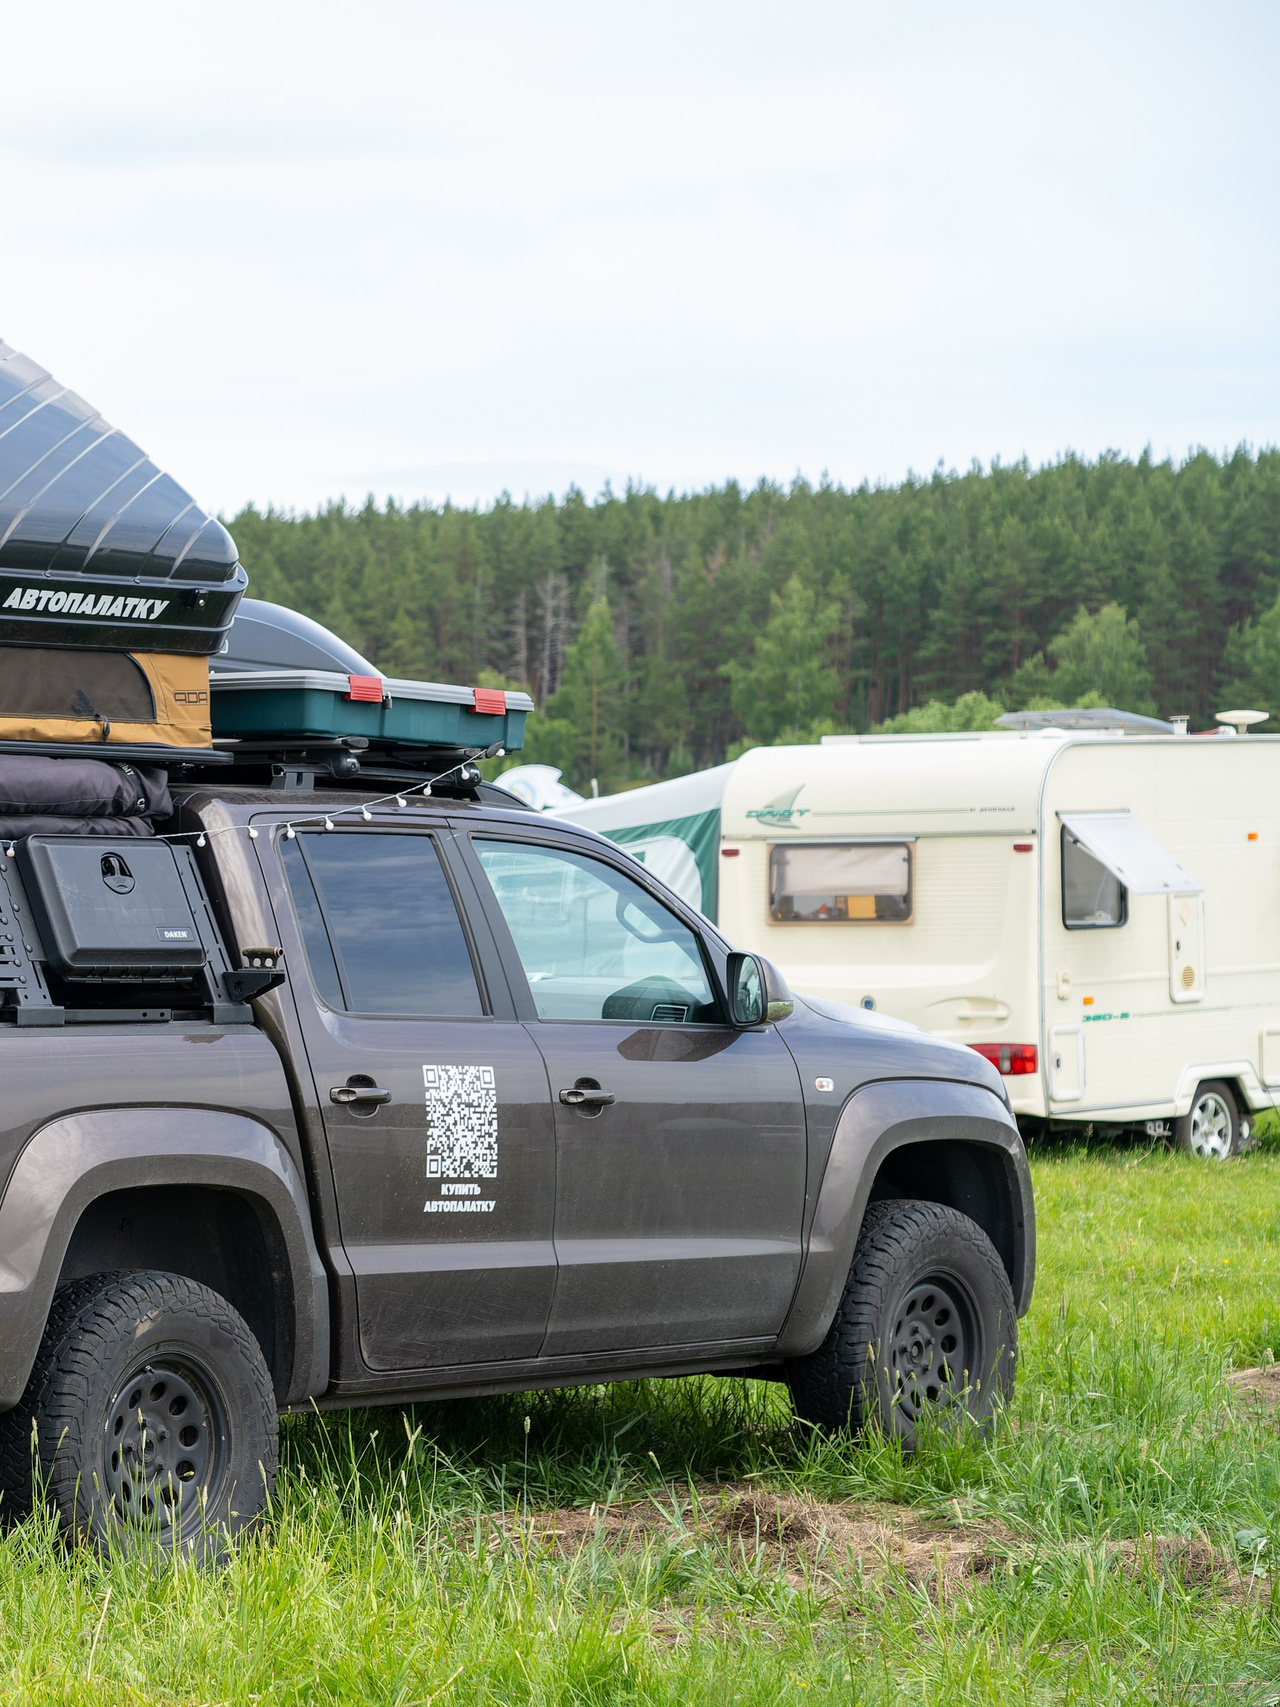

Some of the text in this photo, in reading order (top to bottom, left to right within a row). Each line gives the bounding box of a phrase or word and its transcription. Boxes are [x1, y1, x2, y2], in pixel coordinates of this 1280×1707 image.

[2, 588, 170, 620] АВТОПАЛАТКУ
[163, 930, 188, 938] DAKEN
[440, 1184, 481, 1196] КУПИТЬ
[423, 1200, 496, 1213] АВТОПАЛАТКУ
